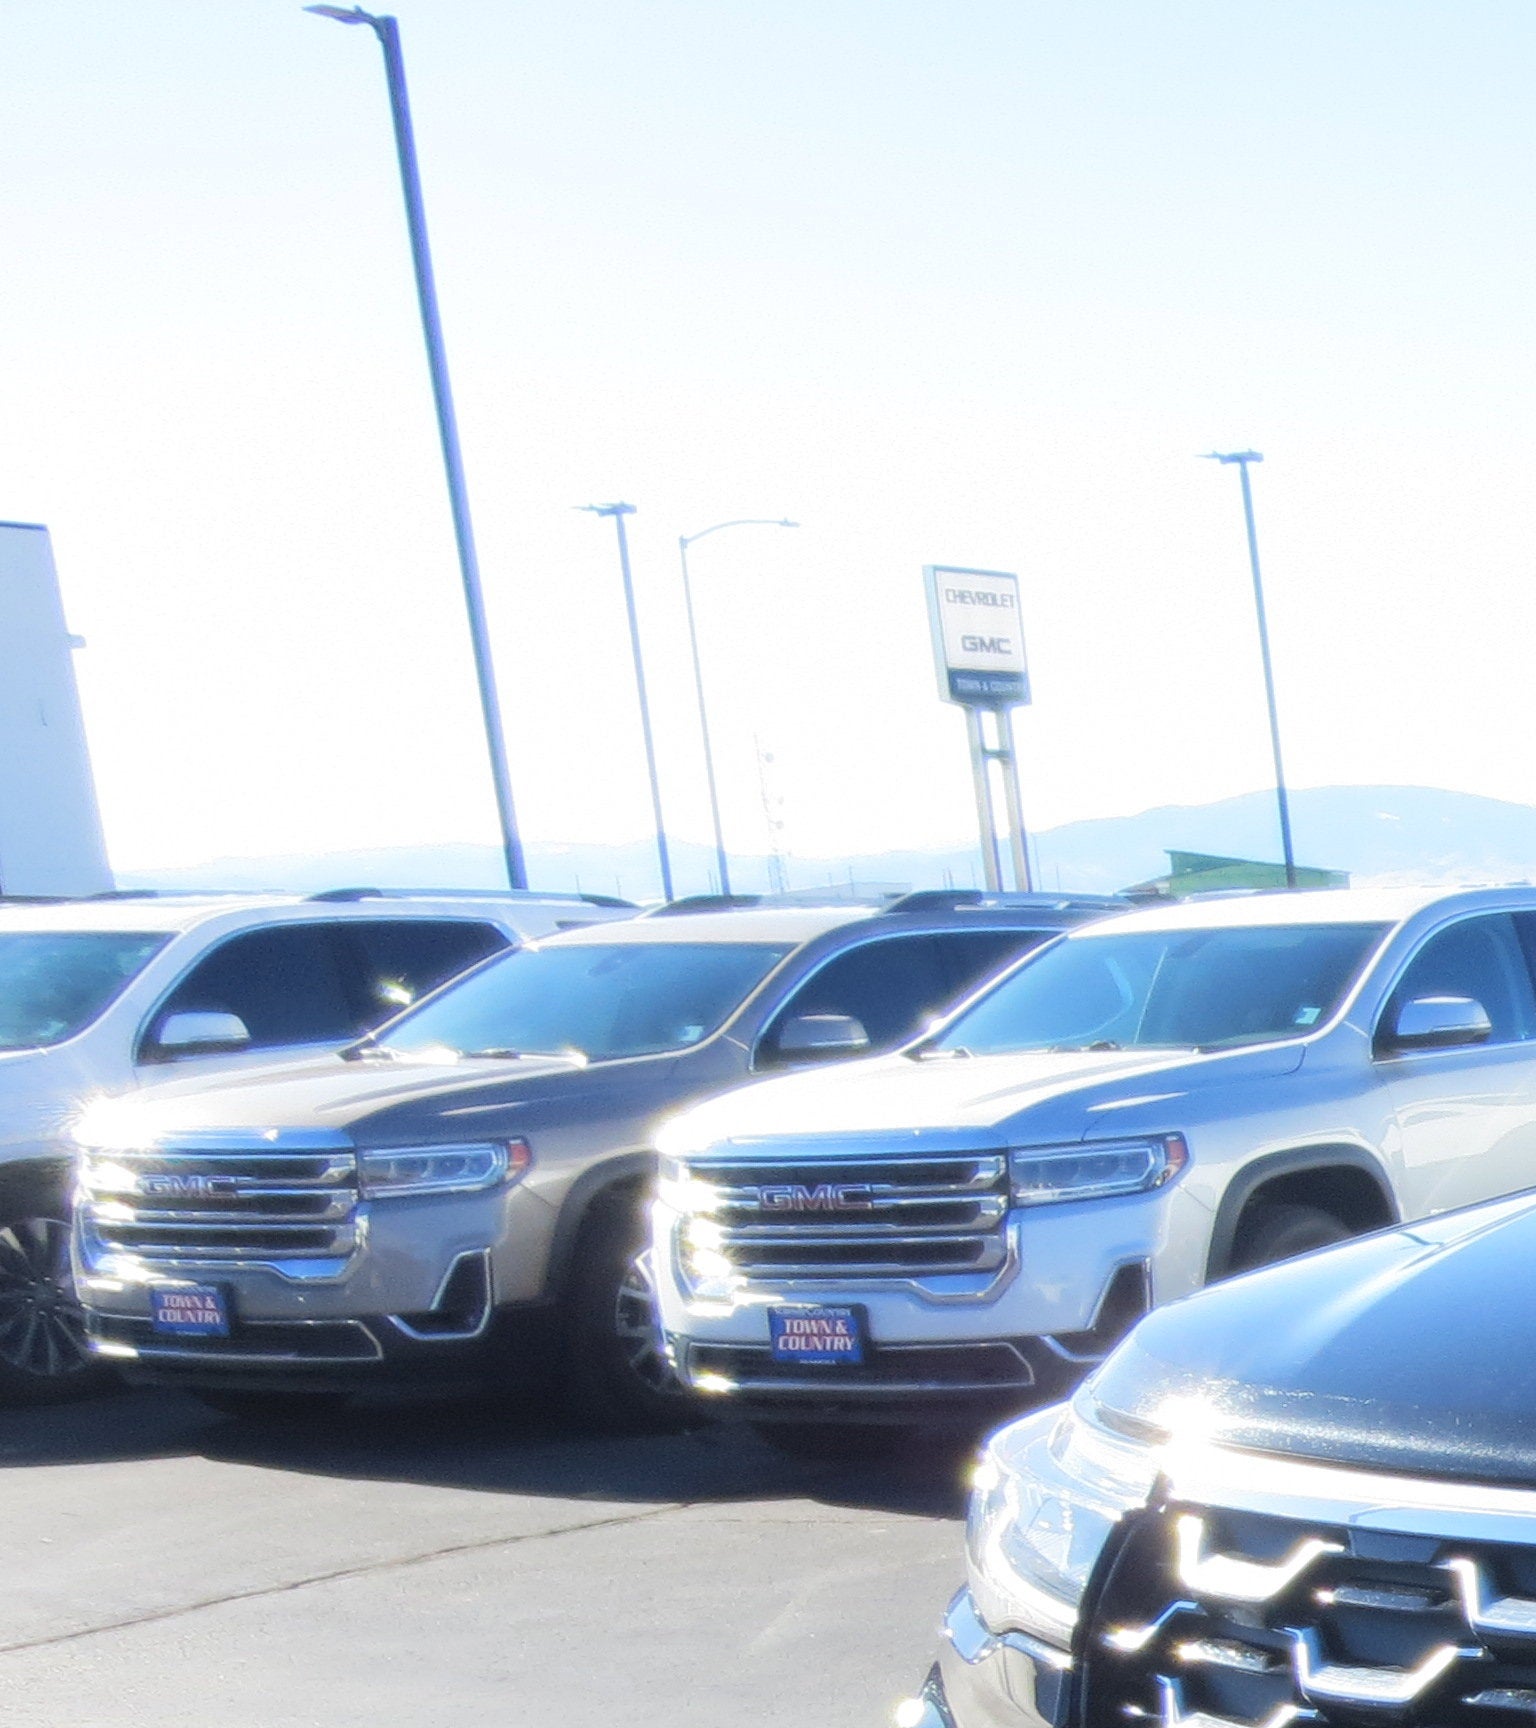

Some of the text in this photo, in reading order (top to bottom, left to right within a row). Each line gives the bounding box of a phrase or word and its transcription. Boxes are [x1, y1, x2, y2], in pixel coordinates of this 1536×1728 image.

[945, 588, 1015, 608] CHEVROLET
[961, 635, 1012, 655] GMC
[142, 1175, 237, 1198] GMC
[757, 1184, 874, 1211] GMC
[163, 1295, 216, 1309] TOWN &
[158, 1309, 222, 1325] COUNTRY
[784, 1319, 848, 1334] TOWN &
[778, 1336, 854, 1351] COUNTRY
